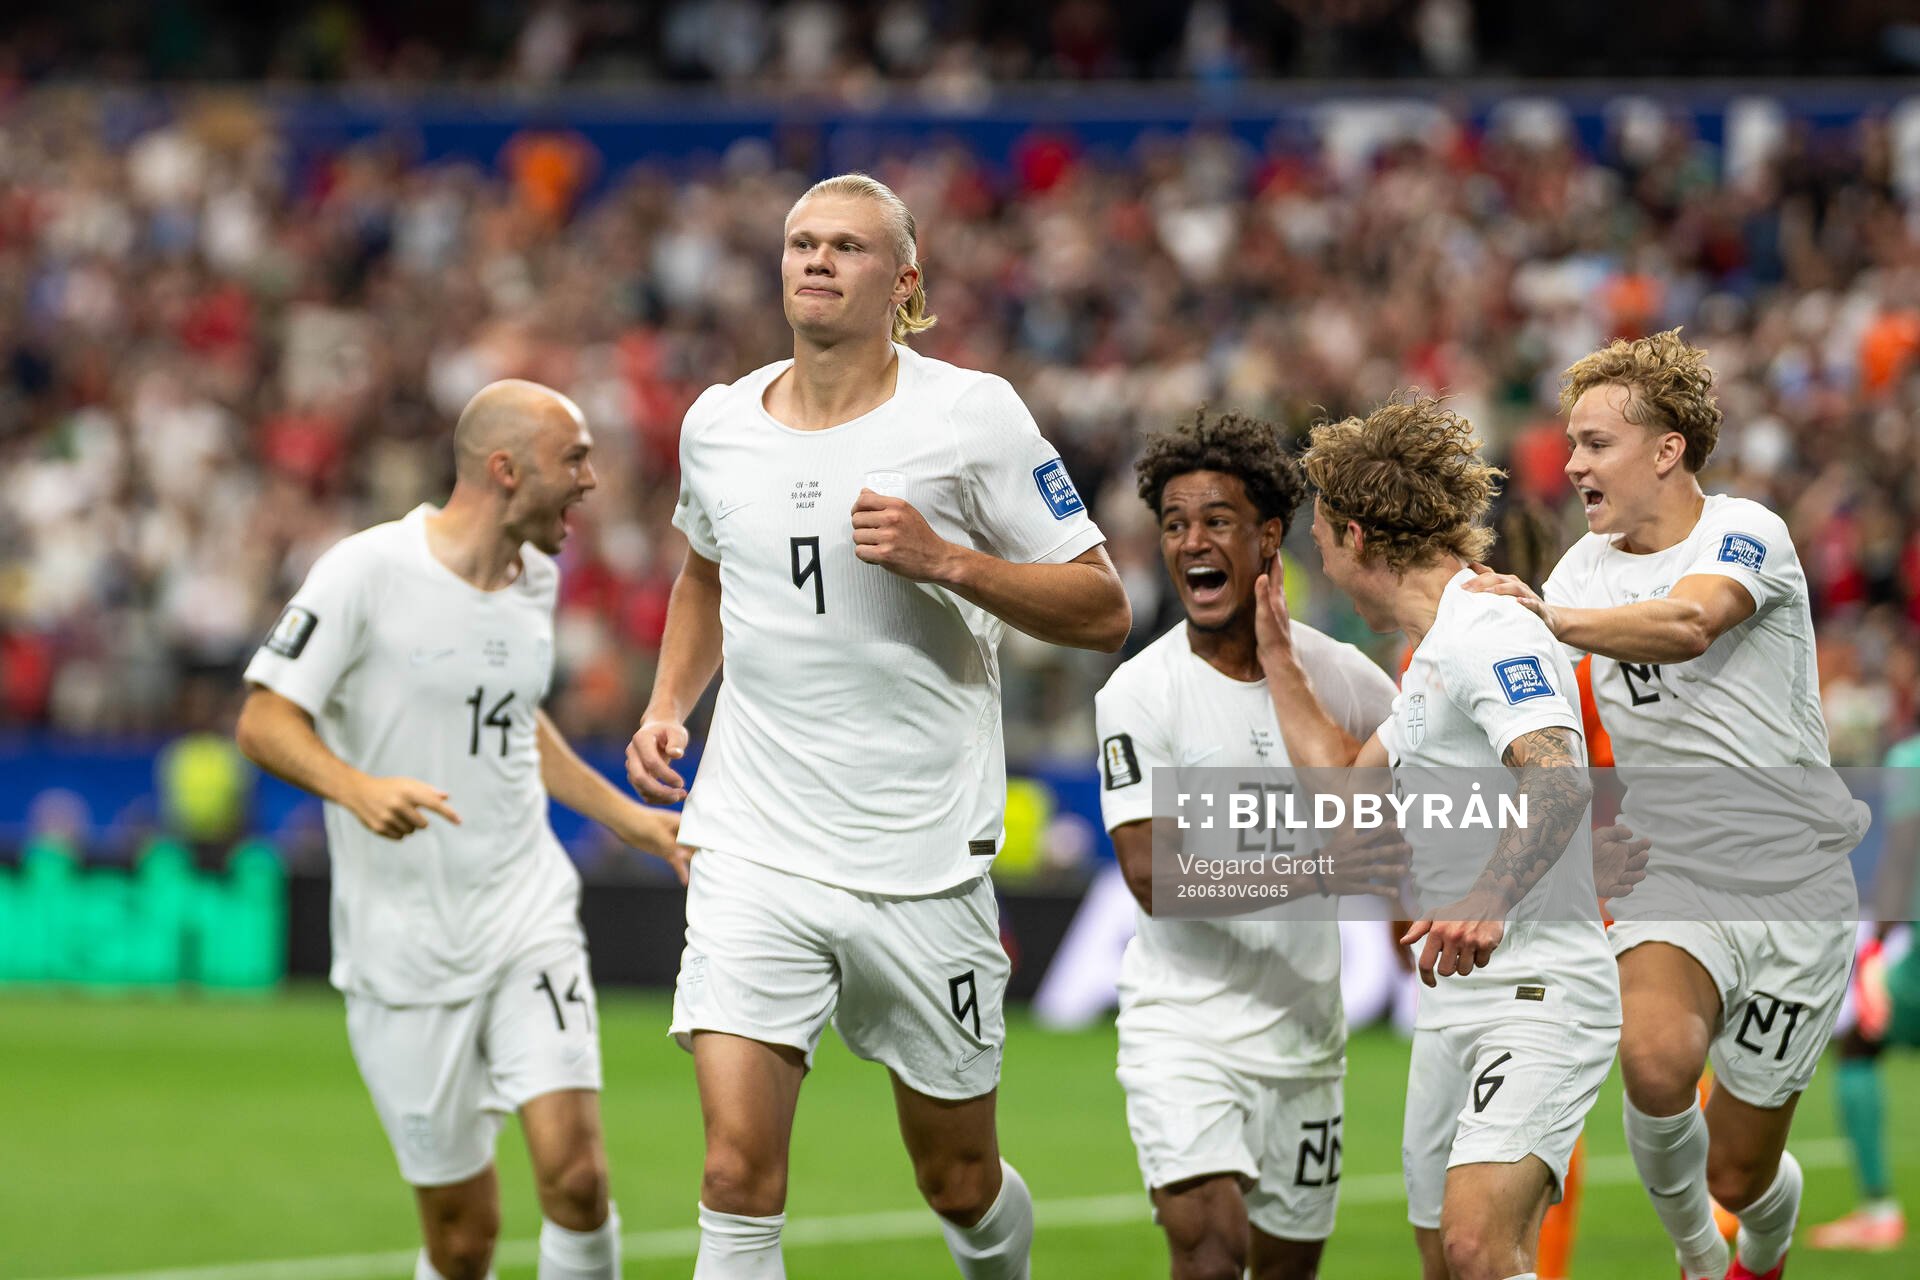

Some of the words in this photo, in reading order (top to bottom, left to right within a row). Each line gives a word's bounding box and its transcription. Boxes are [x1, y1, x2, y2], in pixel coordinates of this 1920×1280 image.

[790, 536, 825, 614] 9
[1731, 537, 1760, 555] FOOTBALL
[1504, 664, 1534, 674] FOOTBALL
[1507, 670, 1538, 684] UNITES
[1510, 682, 1522, 692] the
[1522, 679, 1543, 688] World
[465, 685, 515, 757] 14
[533, 971, 591, 1034] 14
[947, 968, 981, 1041] 9
[1735, 990, 1803, 1061] 21
[1474, 1051, 1512, 1113] 6
